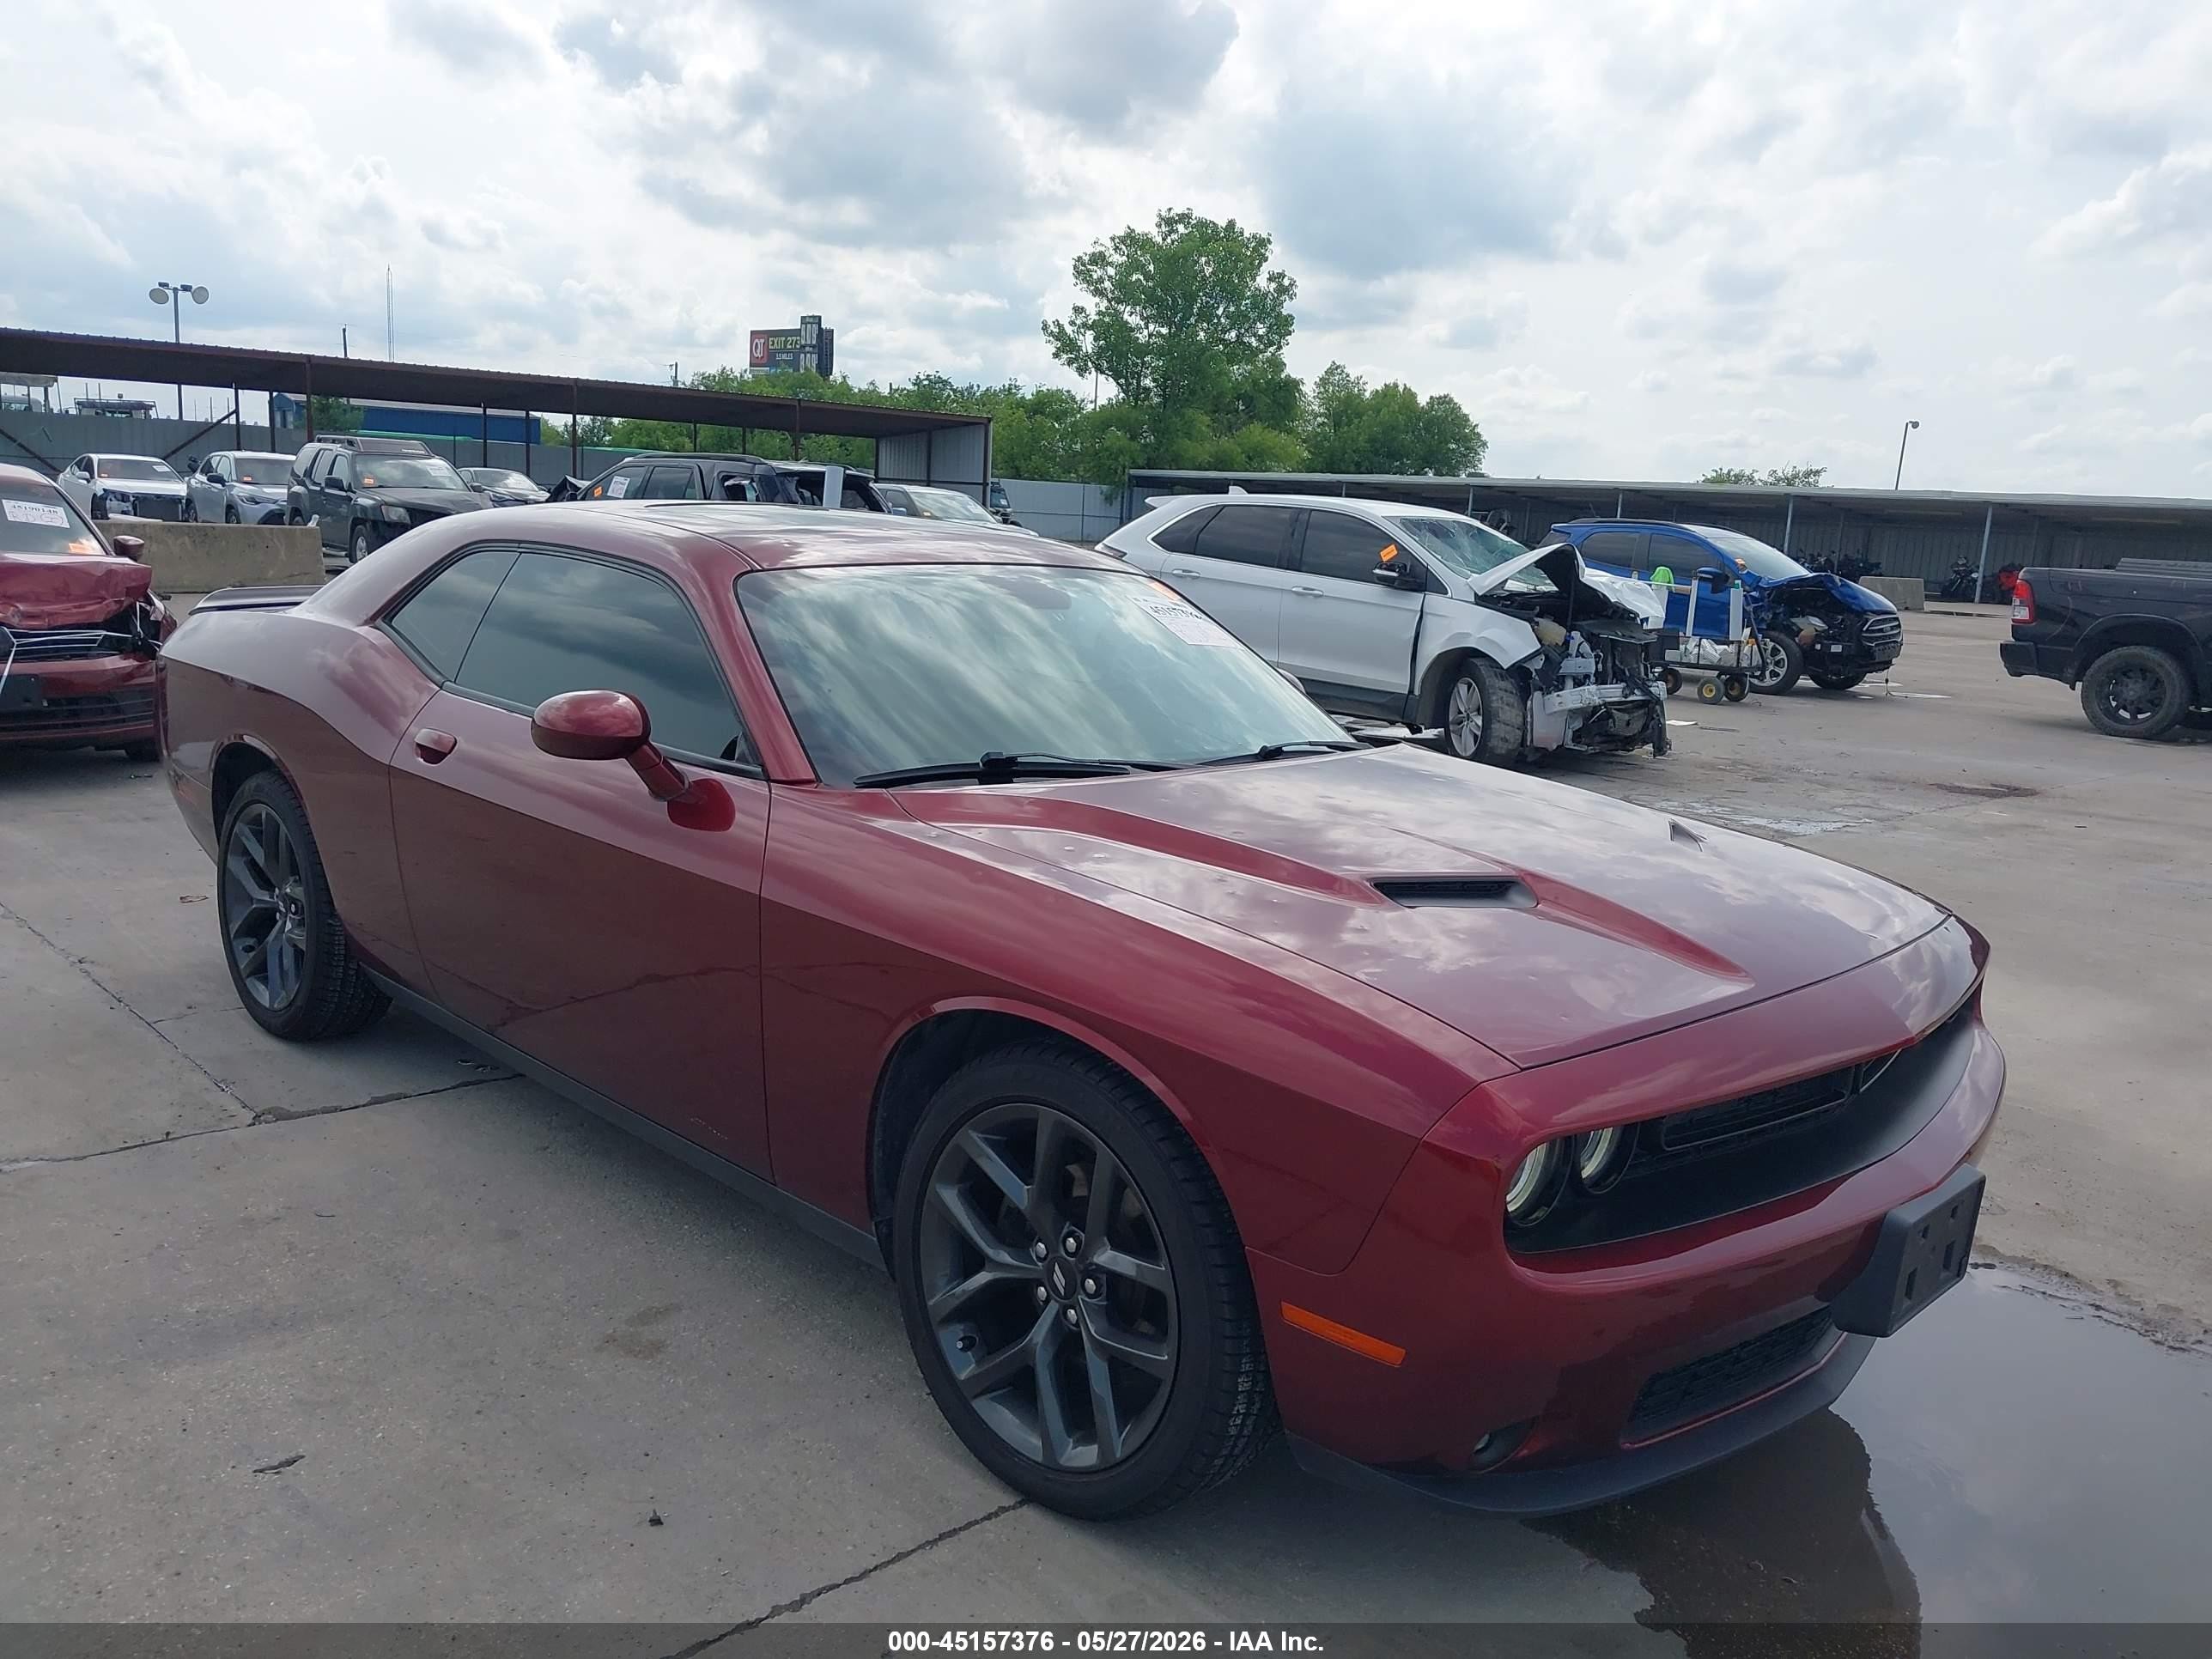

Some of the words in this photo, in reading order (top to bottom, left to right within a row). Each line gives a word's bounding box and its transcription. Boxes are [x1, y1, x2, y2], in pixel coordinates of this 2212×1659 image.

[752, 338, 765, 357] QT
[769, 337, 786, 349] EXIT
[787, 336, 800, 349] 273
